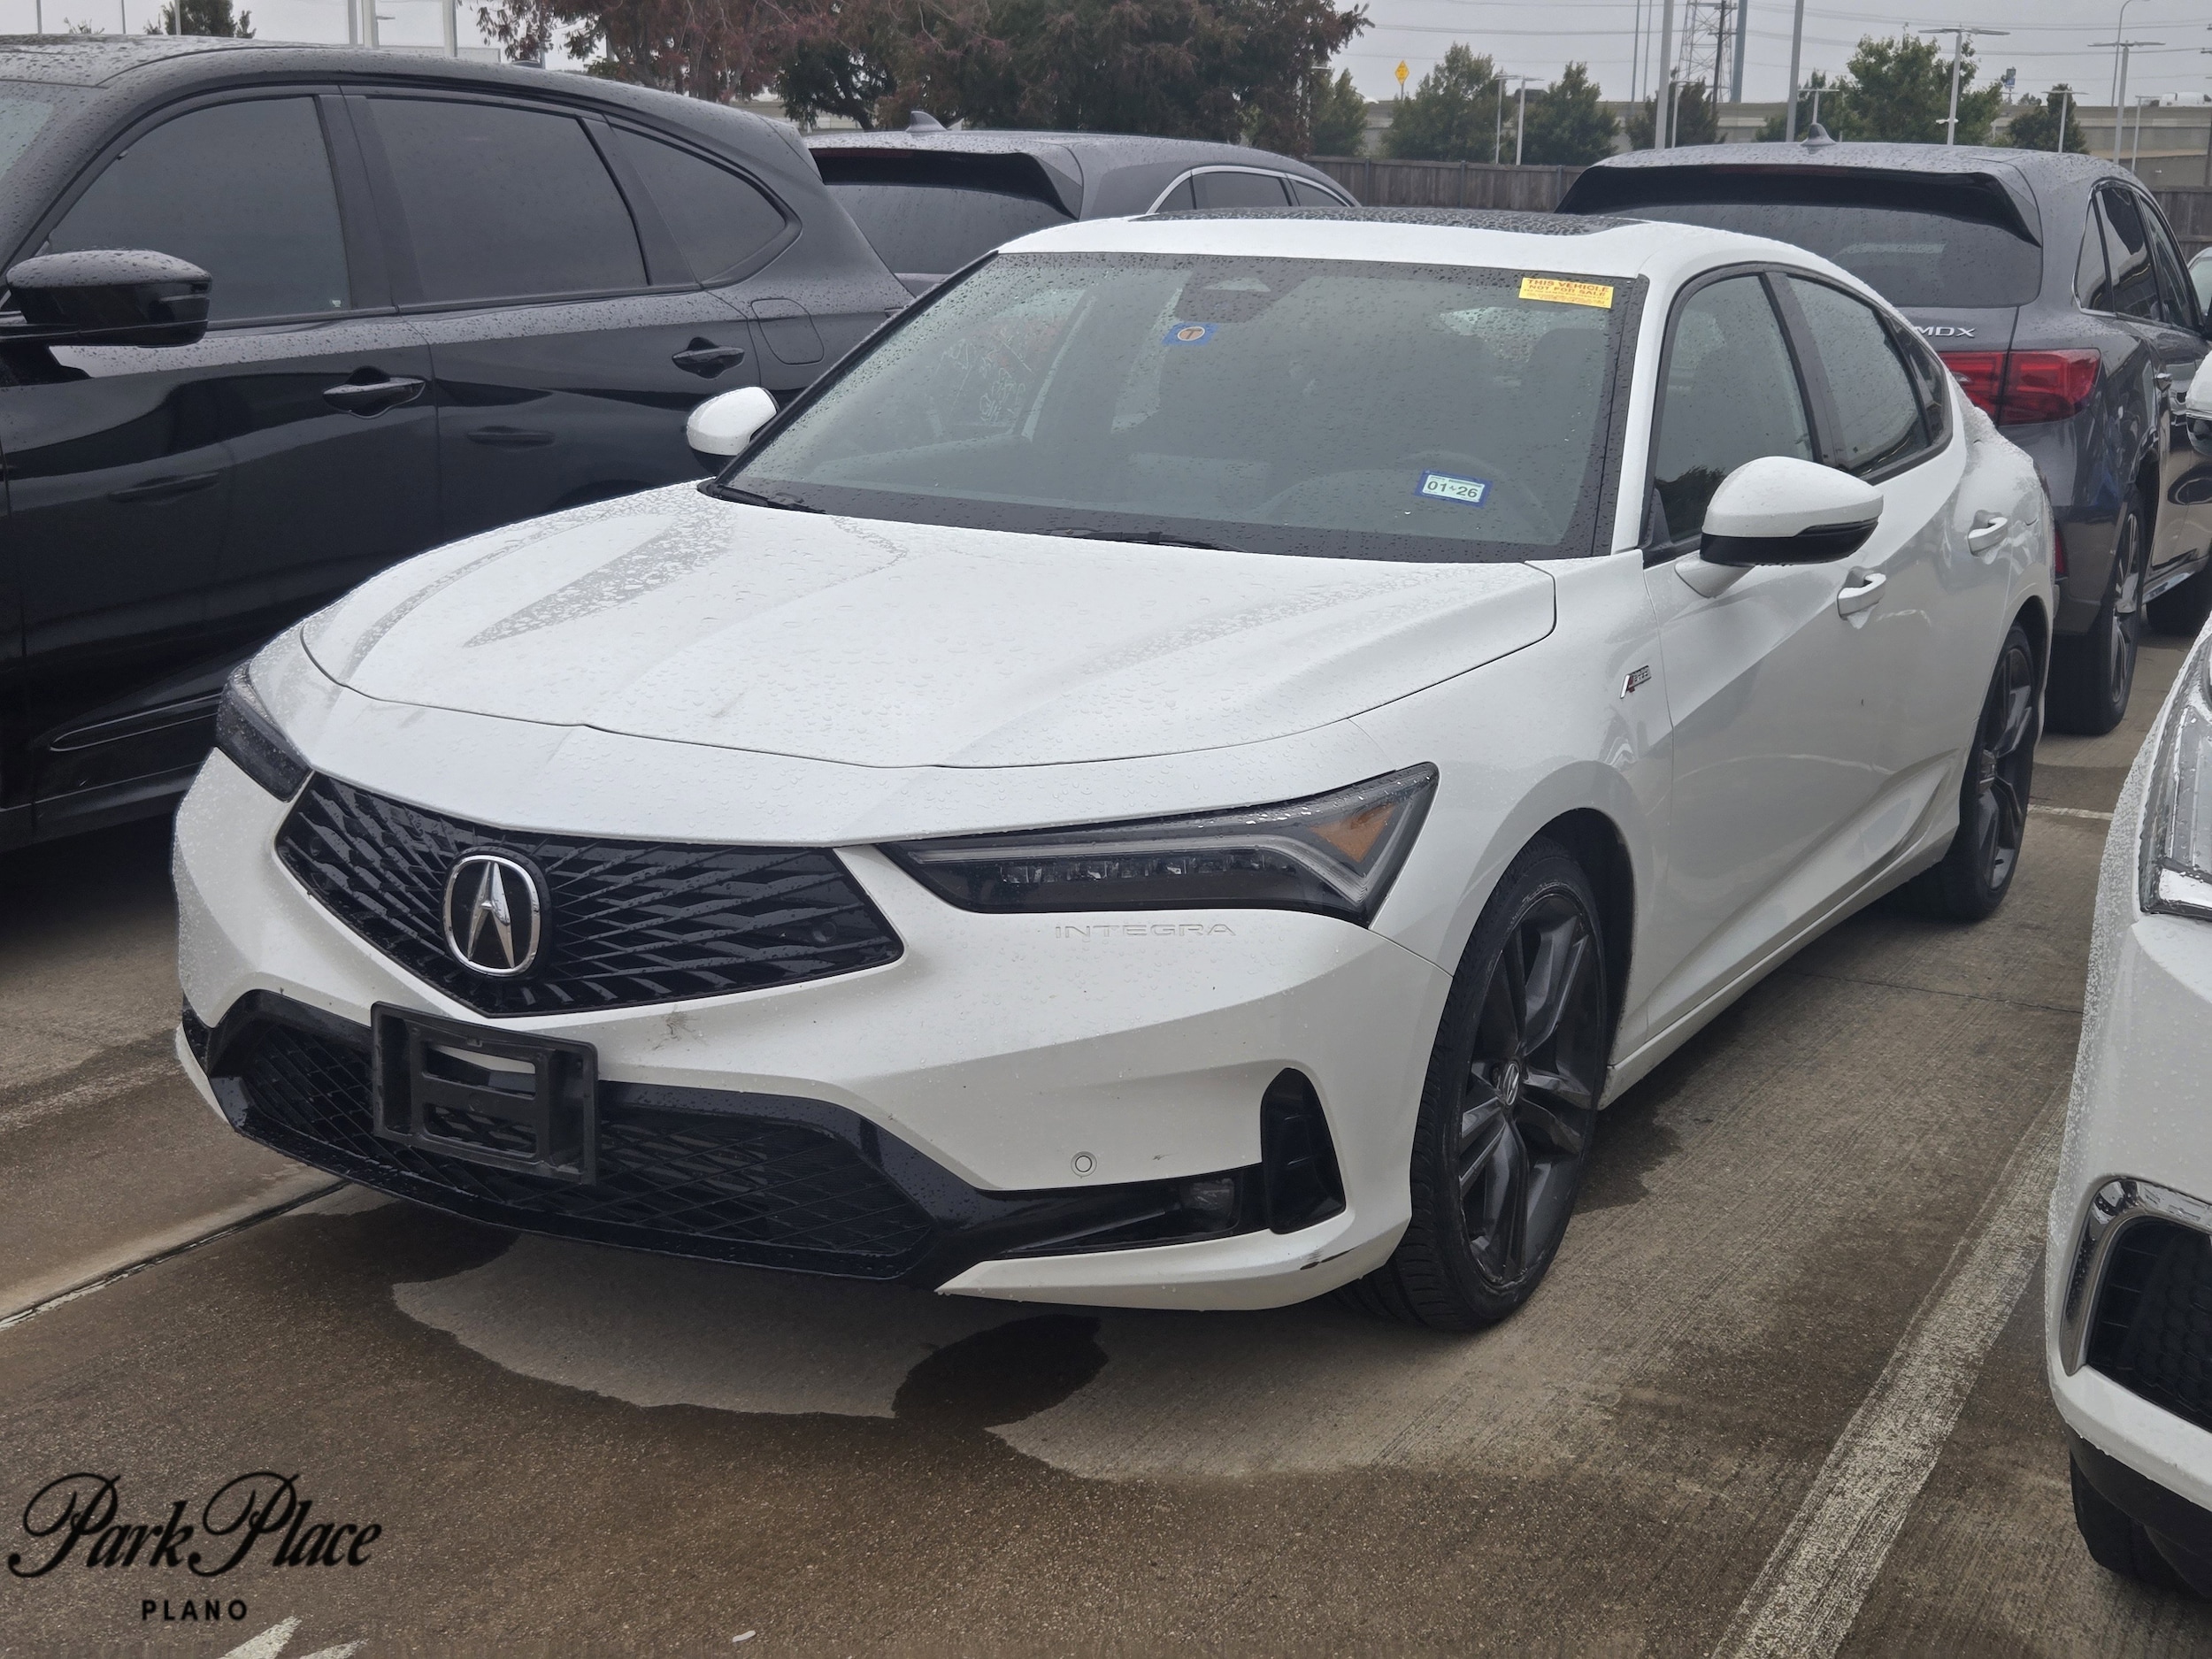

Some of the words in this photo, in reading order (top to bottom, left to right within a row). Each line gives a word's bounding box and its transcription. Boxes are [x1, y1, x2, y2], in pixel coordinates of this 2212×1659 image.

[1557, 280, 1609, 293] VEHICLE
[1913, 326, 1977, 338] MDX
[1055, 923, 1237, 940] INTEGRA
